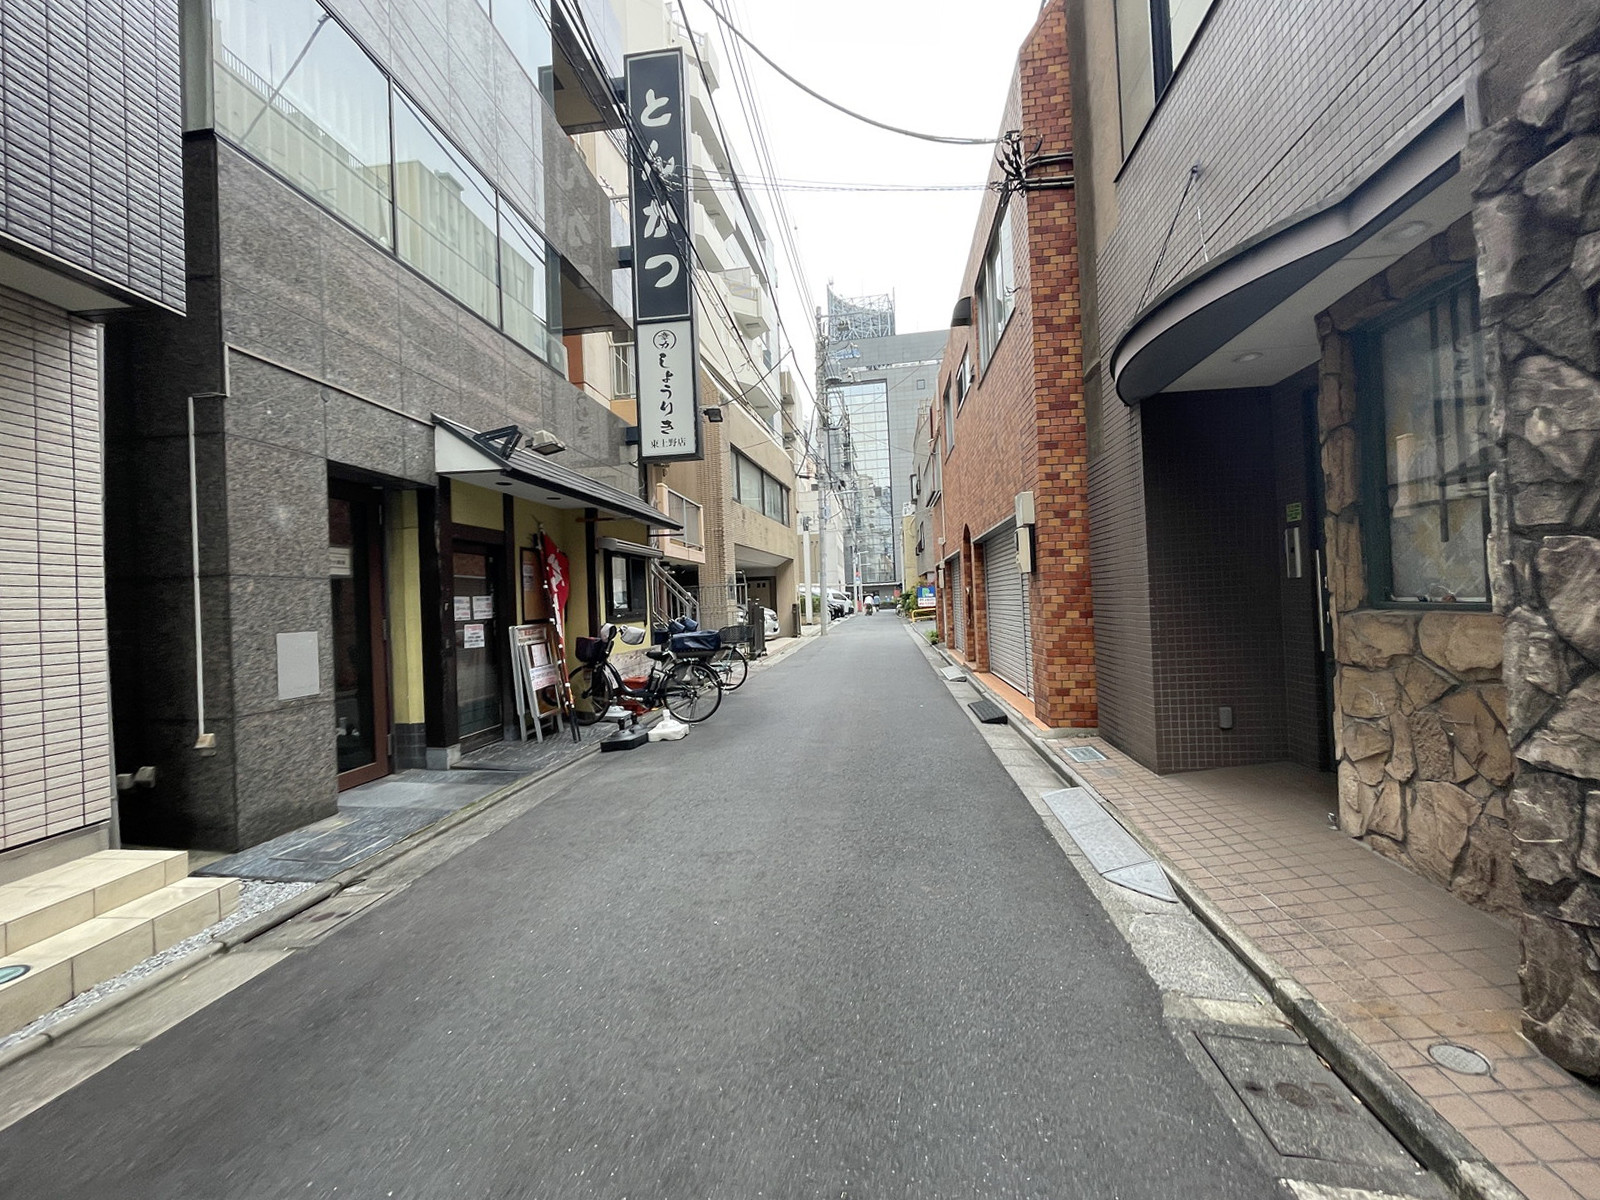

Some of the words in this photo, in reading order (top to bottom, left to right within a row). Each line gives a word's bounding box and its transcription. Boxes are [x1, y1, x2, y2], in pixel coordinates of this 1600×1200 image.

[658, 352, 674, 435] しょうりき
[650, 437, 687, 449] 東上野店
